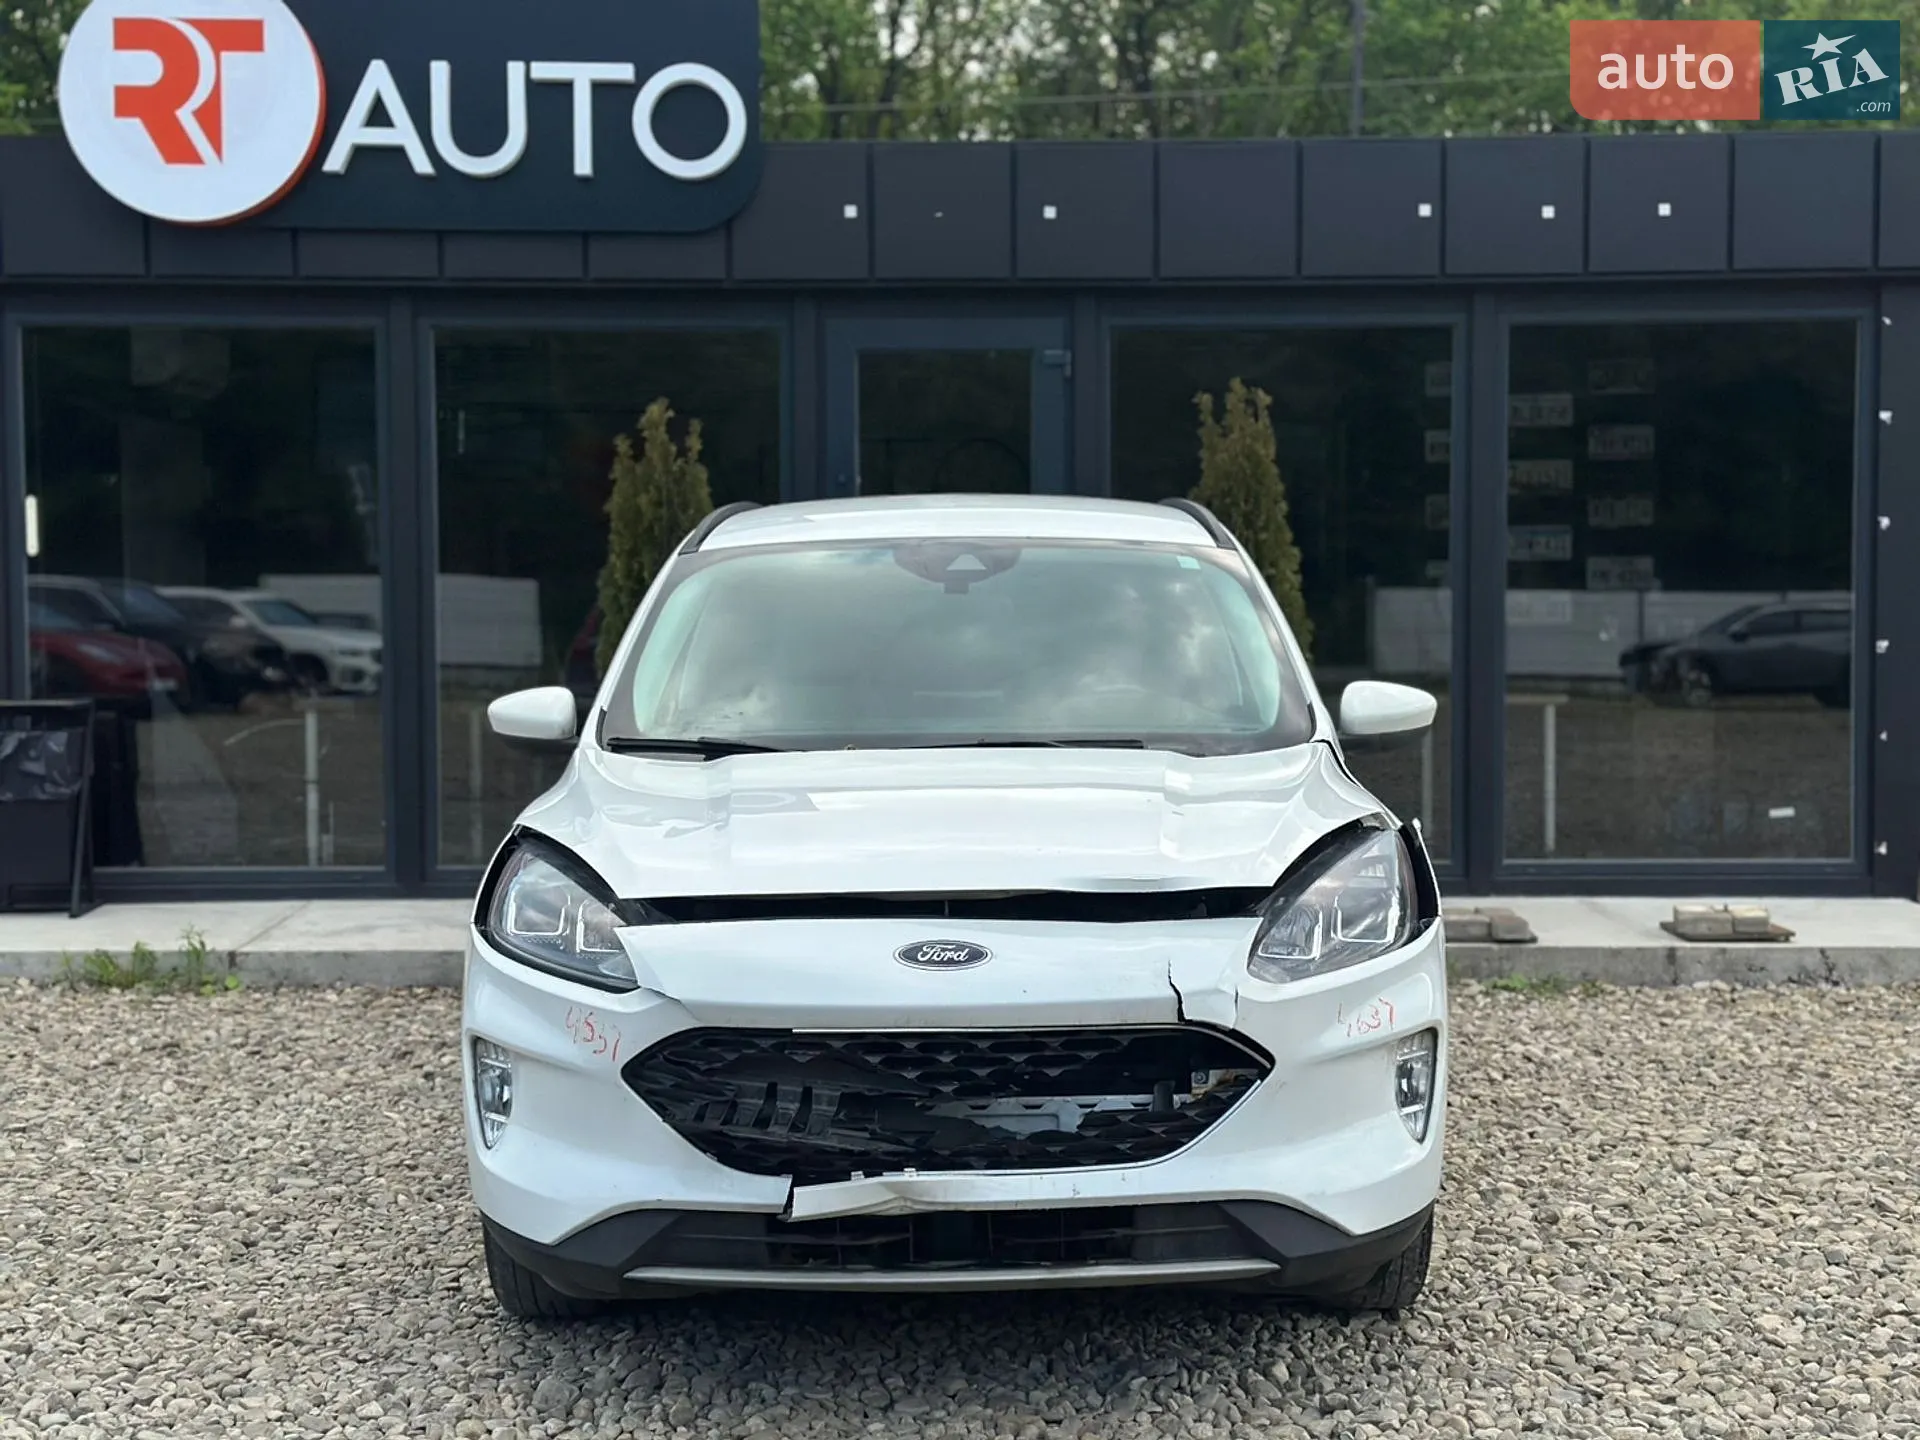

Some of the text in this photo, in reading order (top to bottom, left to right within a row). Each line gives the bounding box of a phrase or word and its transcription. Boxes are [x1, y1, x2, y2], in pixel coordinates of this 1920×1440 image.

[113, 17, 748, 180] RT AUTO
[918, 944, 969, 962] Ford
